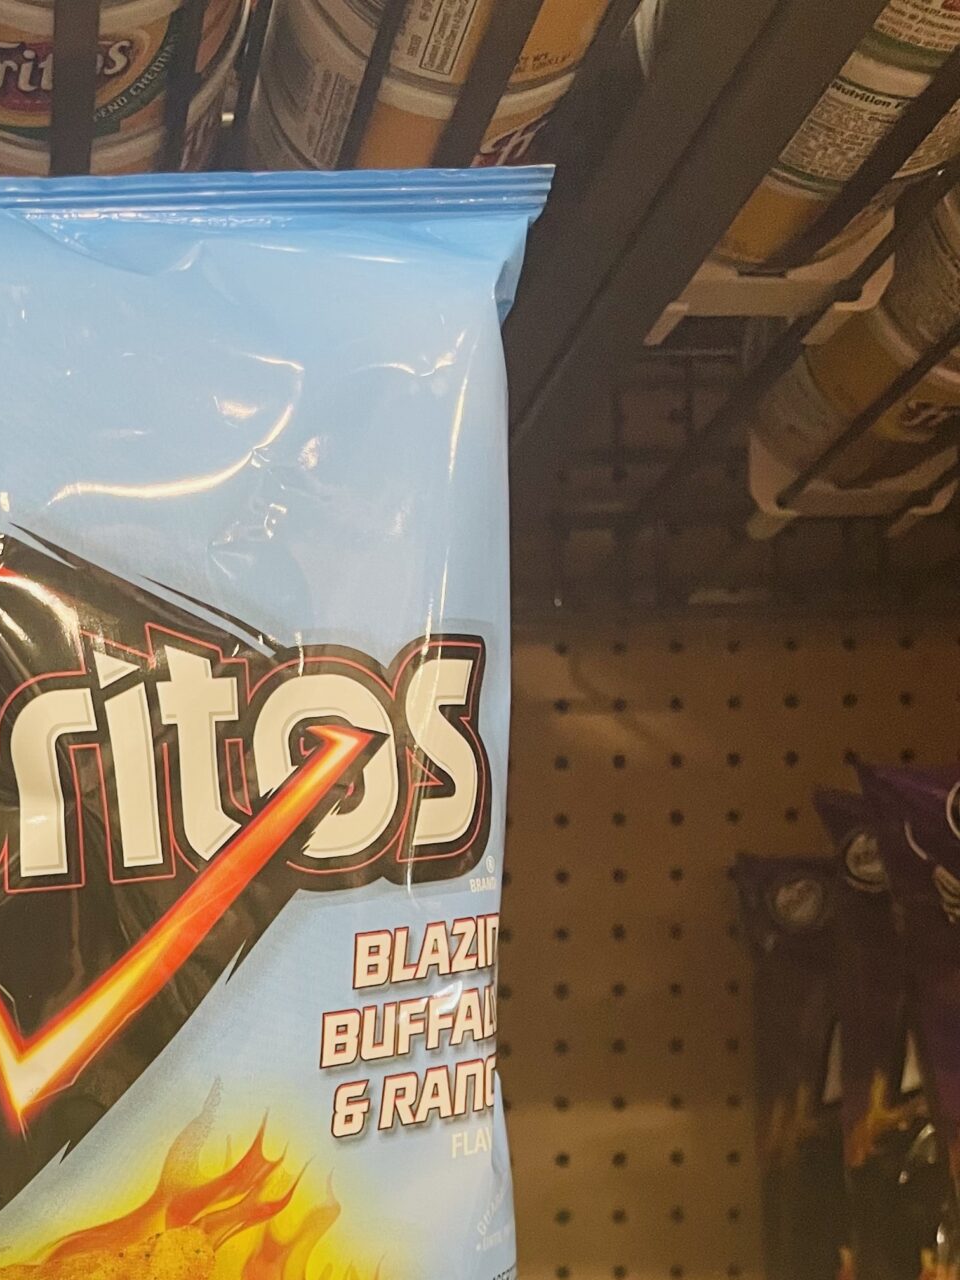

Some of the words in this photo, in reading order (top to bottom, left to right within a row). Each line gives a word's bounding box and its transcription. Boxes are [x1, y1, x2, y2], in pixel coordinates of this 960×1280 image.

[320, 984, 497, 1069] BUFFAL
[331, 1079, 370, 1138] &
[378, 1055, 496, 1131] RANC
